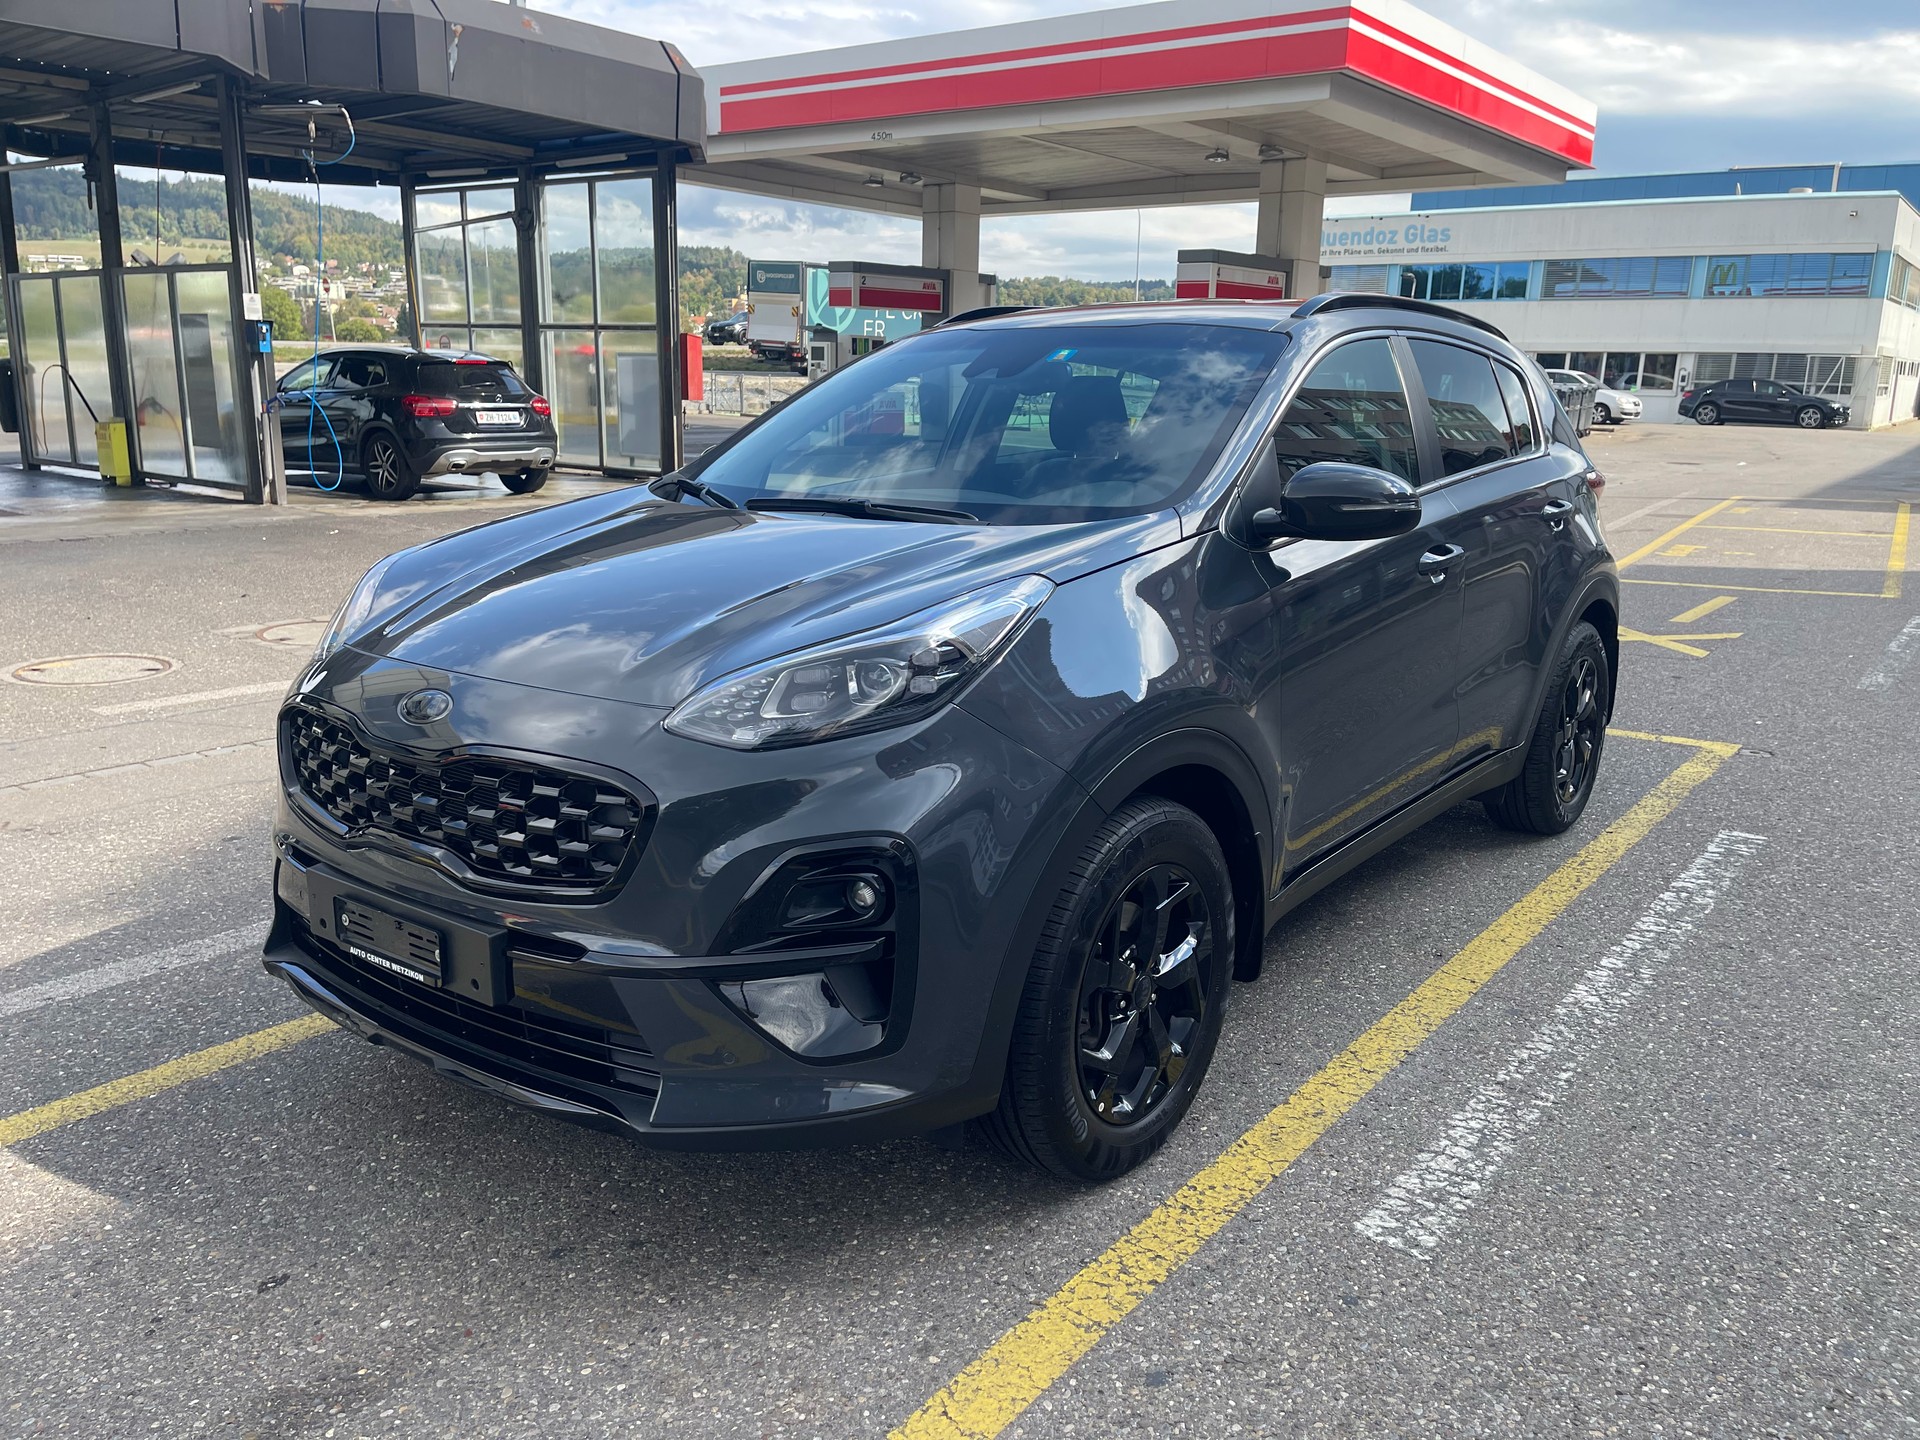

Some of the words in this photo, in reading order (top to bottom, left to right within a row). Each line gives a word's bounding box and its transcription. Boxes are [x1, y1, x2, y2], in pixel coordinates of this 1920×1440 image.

[1405, 225, 1451, 244] Glas
[861, 275, 866, 285] 2
[350, 946, 366, 958] AUTO
[366, 953, 391, 969] CENTER
[391, 962, 424, 982] WETZIKON
